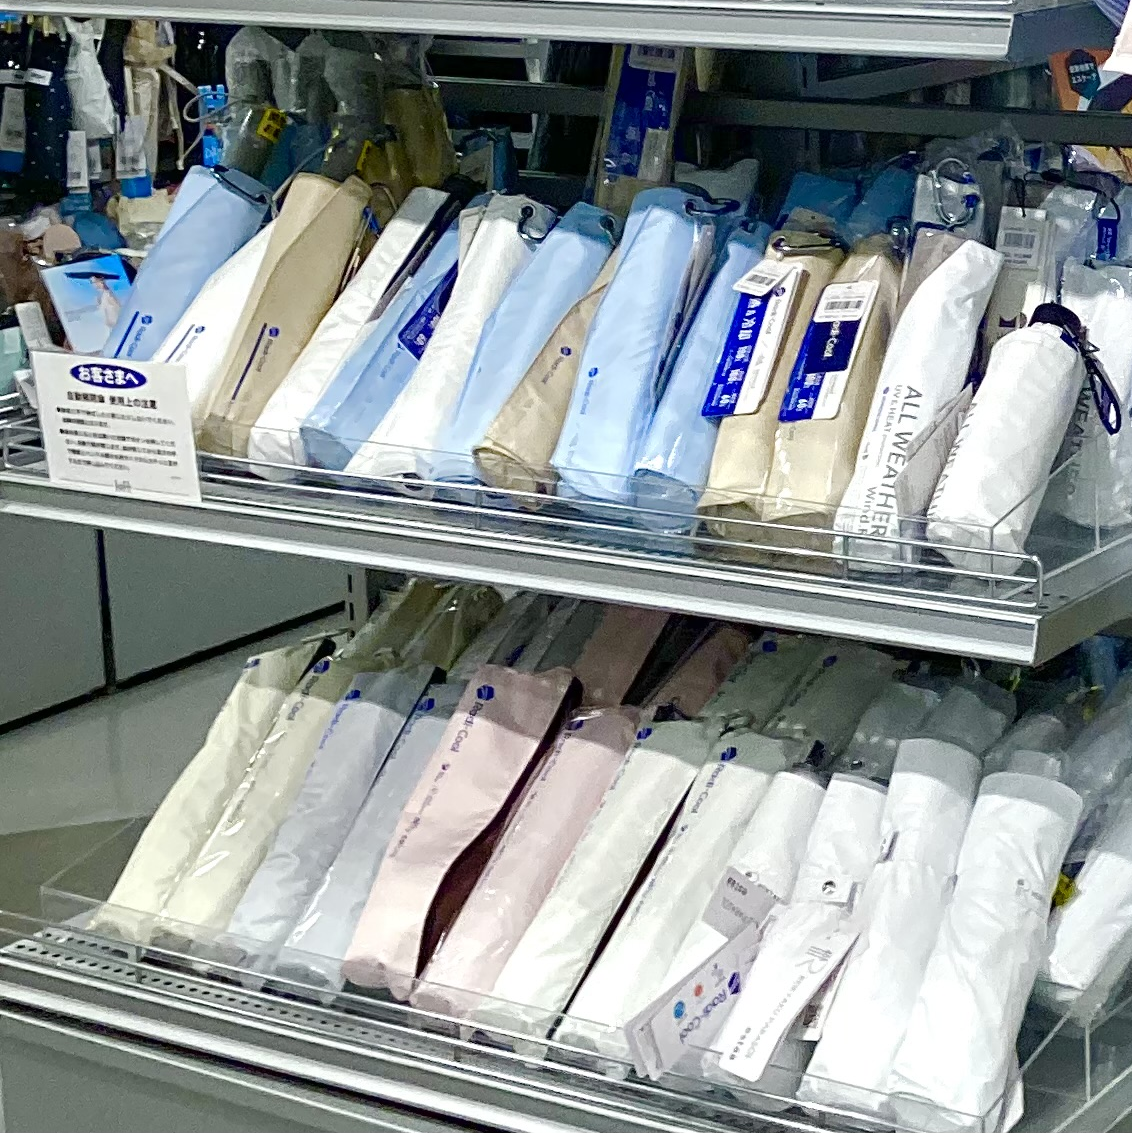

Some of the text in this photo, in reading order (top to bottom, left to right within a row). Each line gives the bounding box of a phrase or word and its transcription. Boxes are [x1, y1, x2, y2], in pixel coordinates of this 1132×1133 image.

[78, 366, 141, 386] お客さまへ
[898, 385, 923, 424] ALL
[869, 431, 914, 537] WEATHER
[450, 701, 484, 753] Radi-Cool
